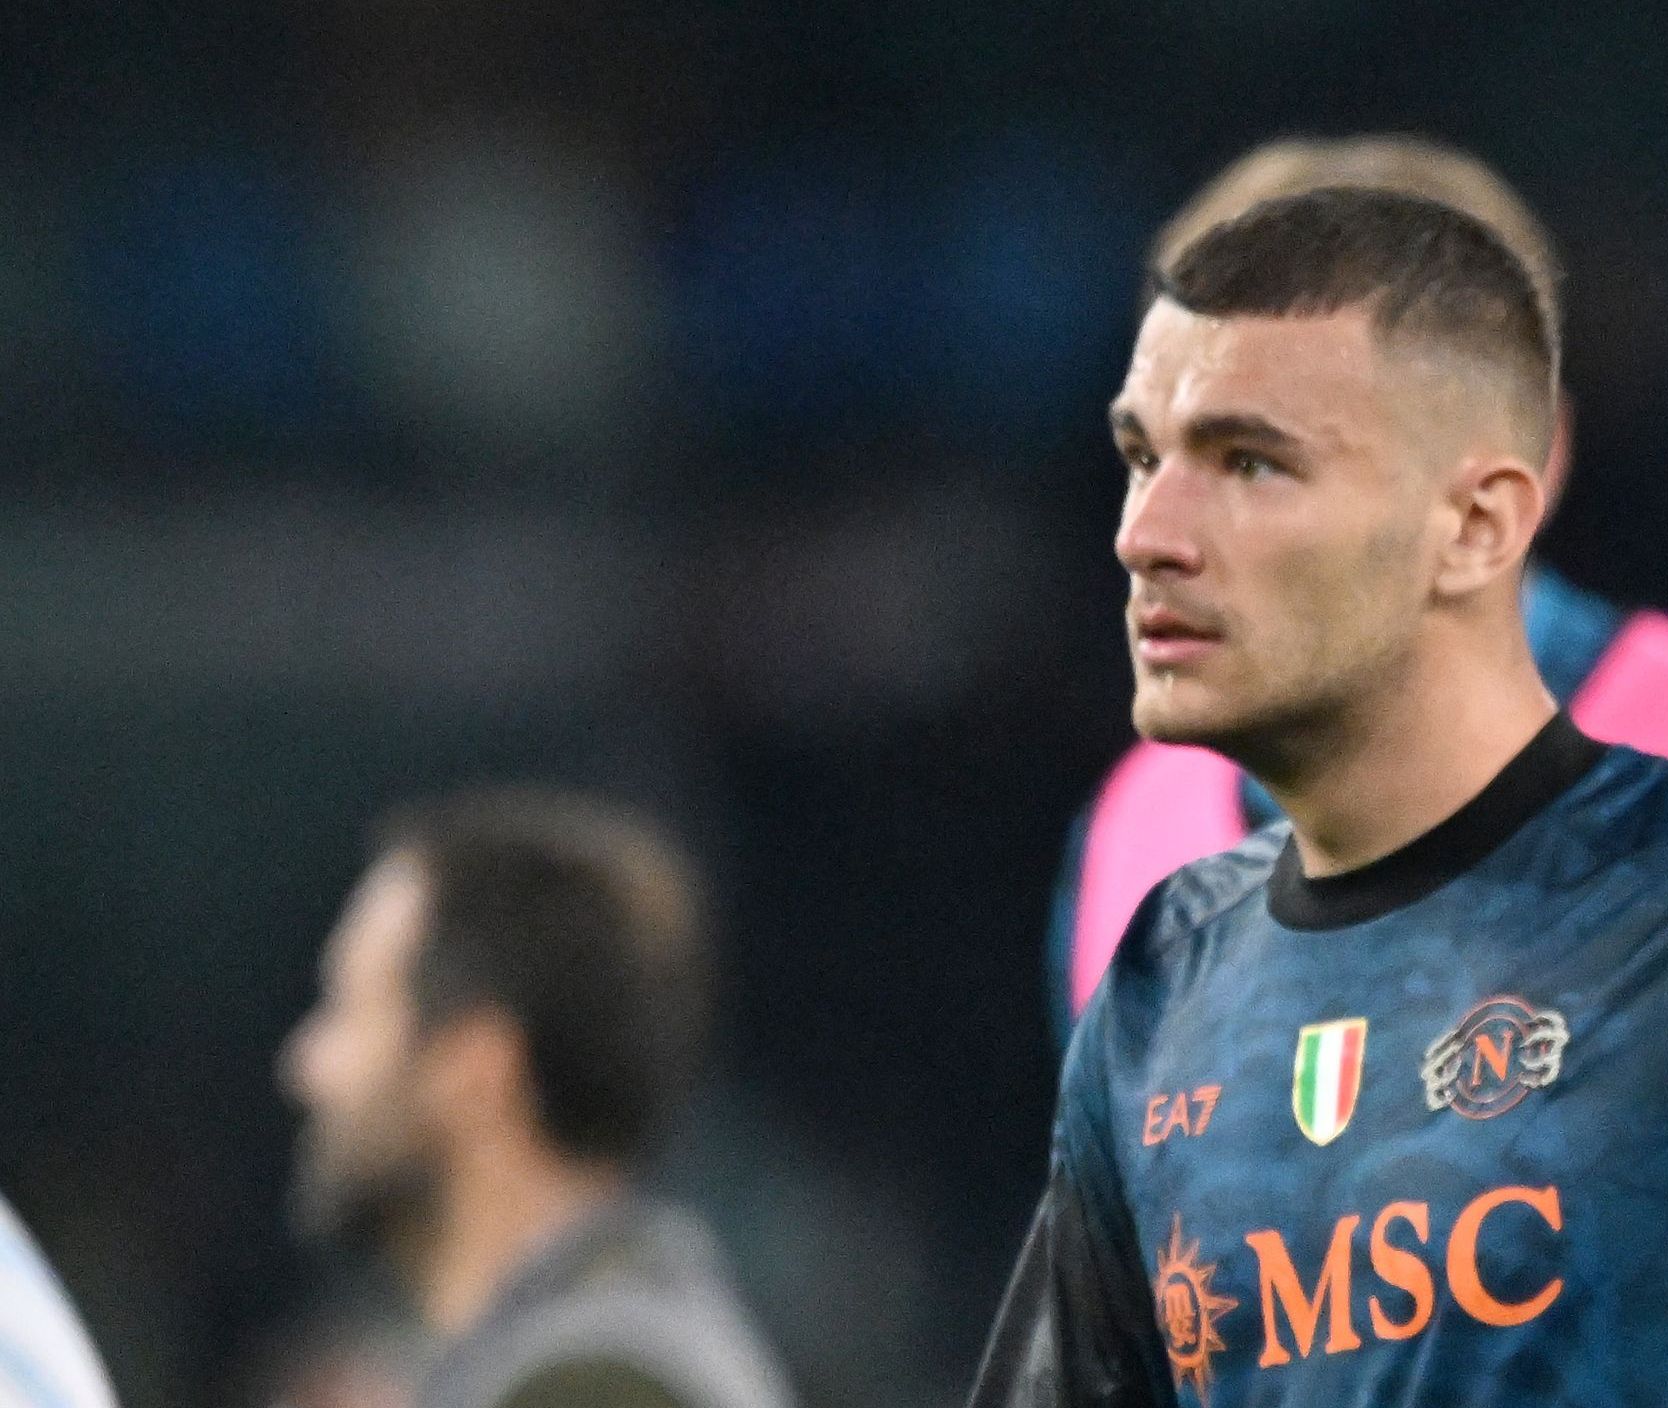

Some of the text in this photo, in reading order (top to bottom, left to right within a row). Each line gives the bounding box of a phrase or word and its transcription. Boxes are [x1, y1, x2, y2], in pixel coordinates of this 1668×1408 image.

[1470, 1030, 1513, 1086] N
[1142, 1085, 1222, 1146] EA7
[1245, 1185, 1564, 1369] MSC
